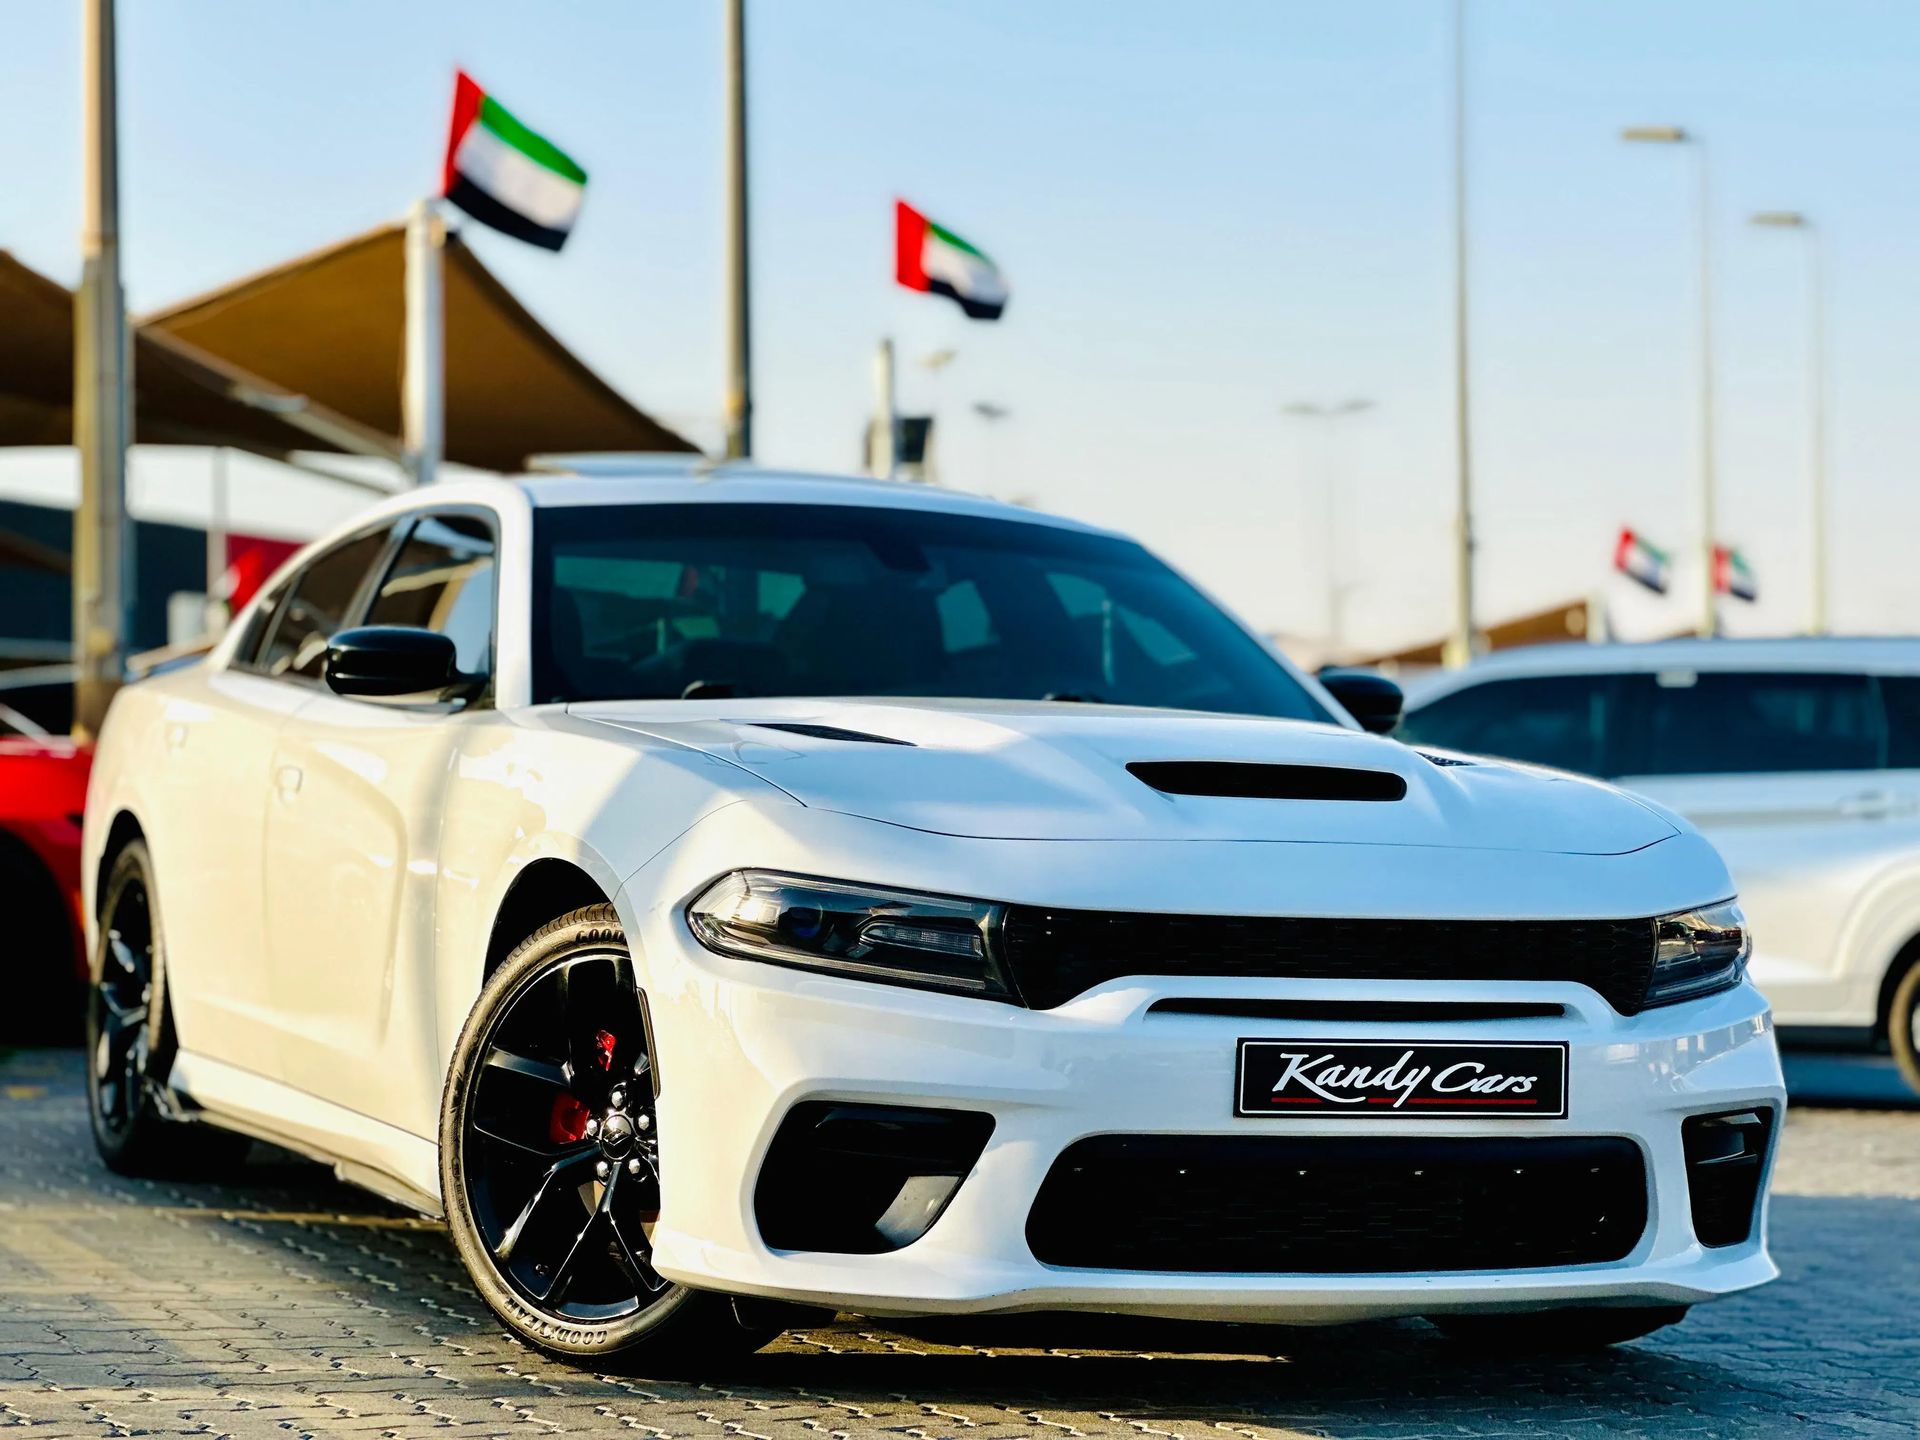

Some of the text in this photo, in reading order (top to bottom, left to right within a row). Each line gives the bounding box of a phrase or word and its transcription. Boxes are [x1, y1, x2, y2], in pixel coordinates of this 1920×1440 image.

[1272, 1050, 1538, 1108] Kandy Cars
[503, 1297, 608, 1346] GOODYEAR
